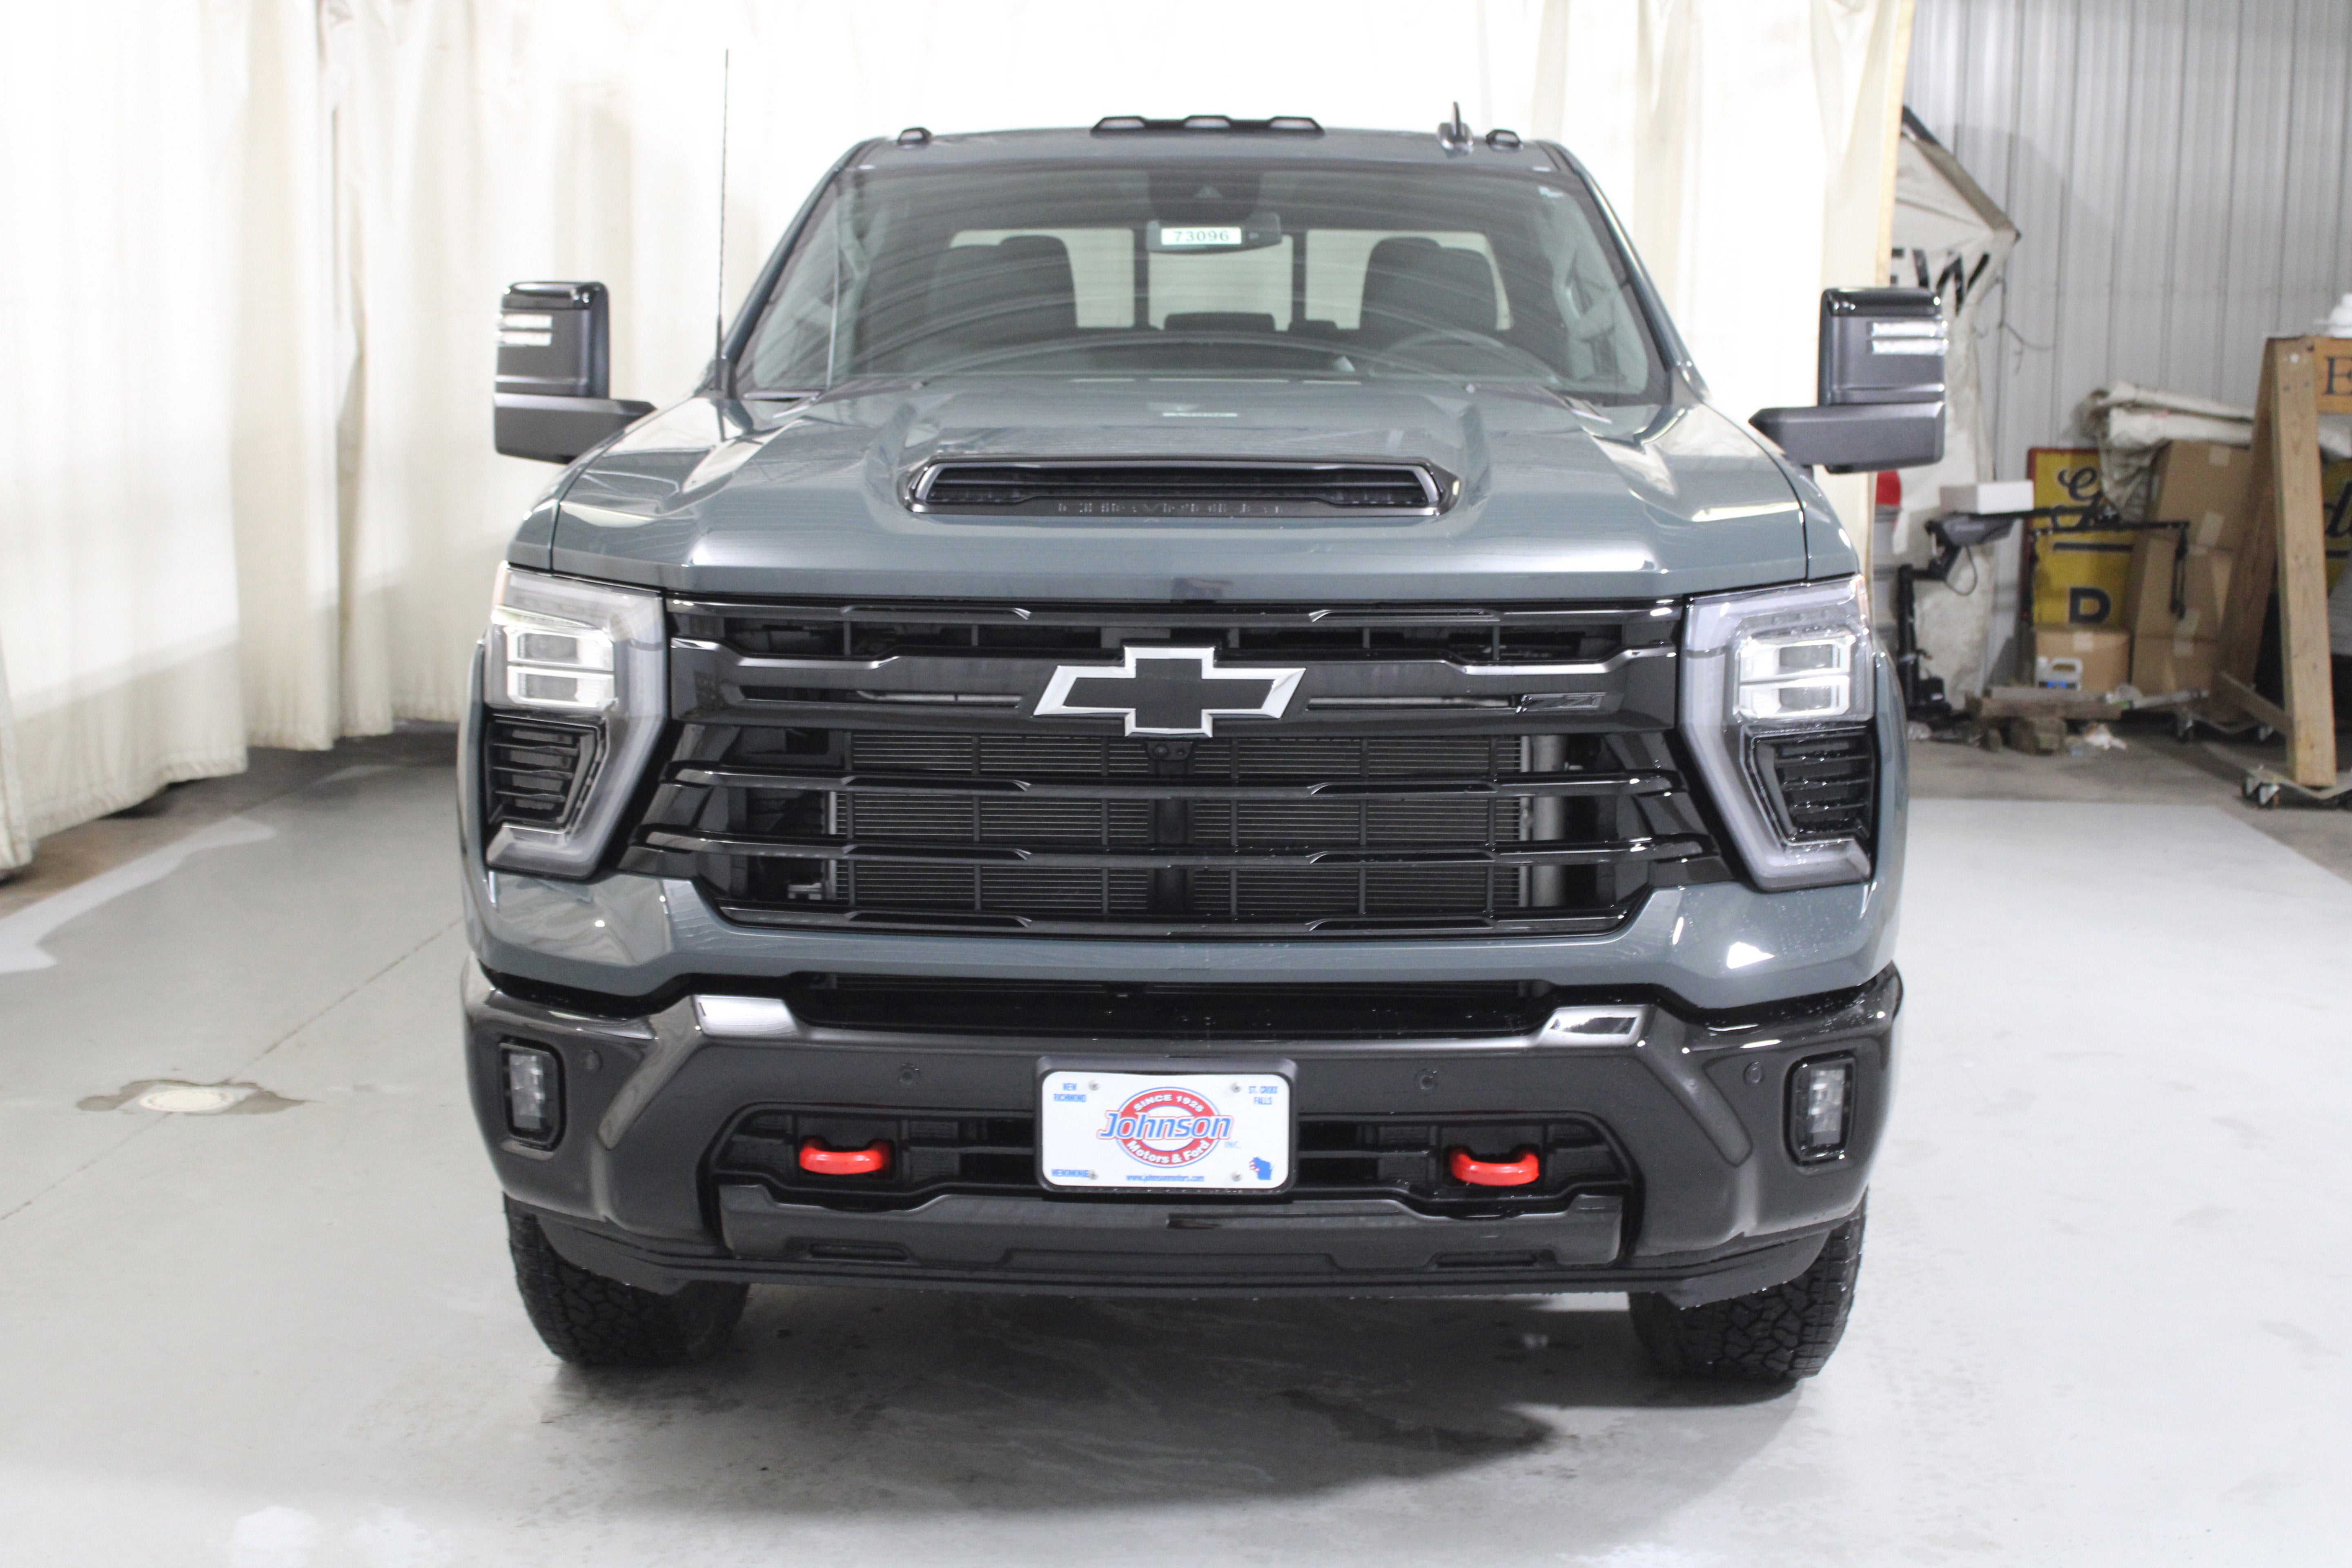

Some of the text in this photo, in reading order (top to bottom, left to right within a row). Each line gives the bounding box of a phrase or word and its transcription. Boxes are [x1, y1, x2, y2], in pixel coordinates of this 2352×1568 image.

[1173, 230, 1229, 242] 73096
[2069, 586, 2111, 624] D
[1062, 1082, 1077, 1091] NEW
[1133, 1094, 1173, 1111] SINCE
[1254, 1097, 1272, 1105] FALLS
[1099, 1111, 1232, 1138] Johnson
[1126, 1140, 1211, 1164] Motors & Ford
